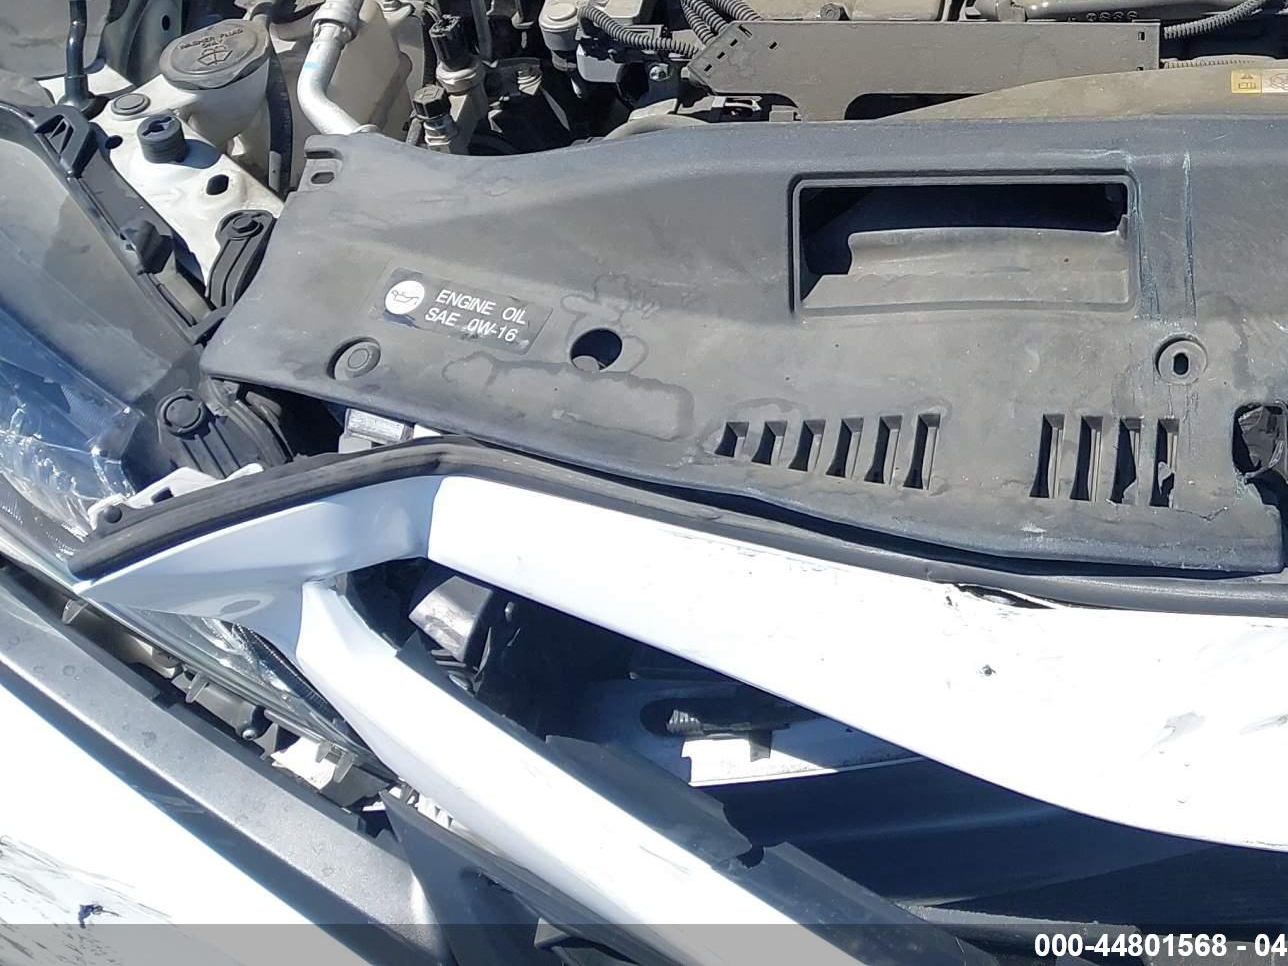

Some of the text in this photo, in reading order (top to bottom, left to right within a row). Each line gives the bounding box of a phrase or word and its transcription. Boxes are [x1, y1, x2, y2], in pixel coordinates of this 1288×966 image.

[425, 307, 519, 342] SAE 0W-16
[435, 289, 527, 325] ENGINE OIL
